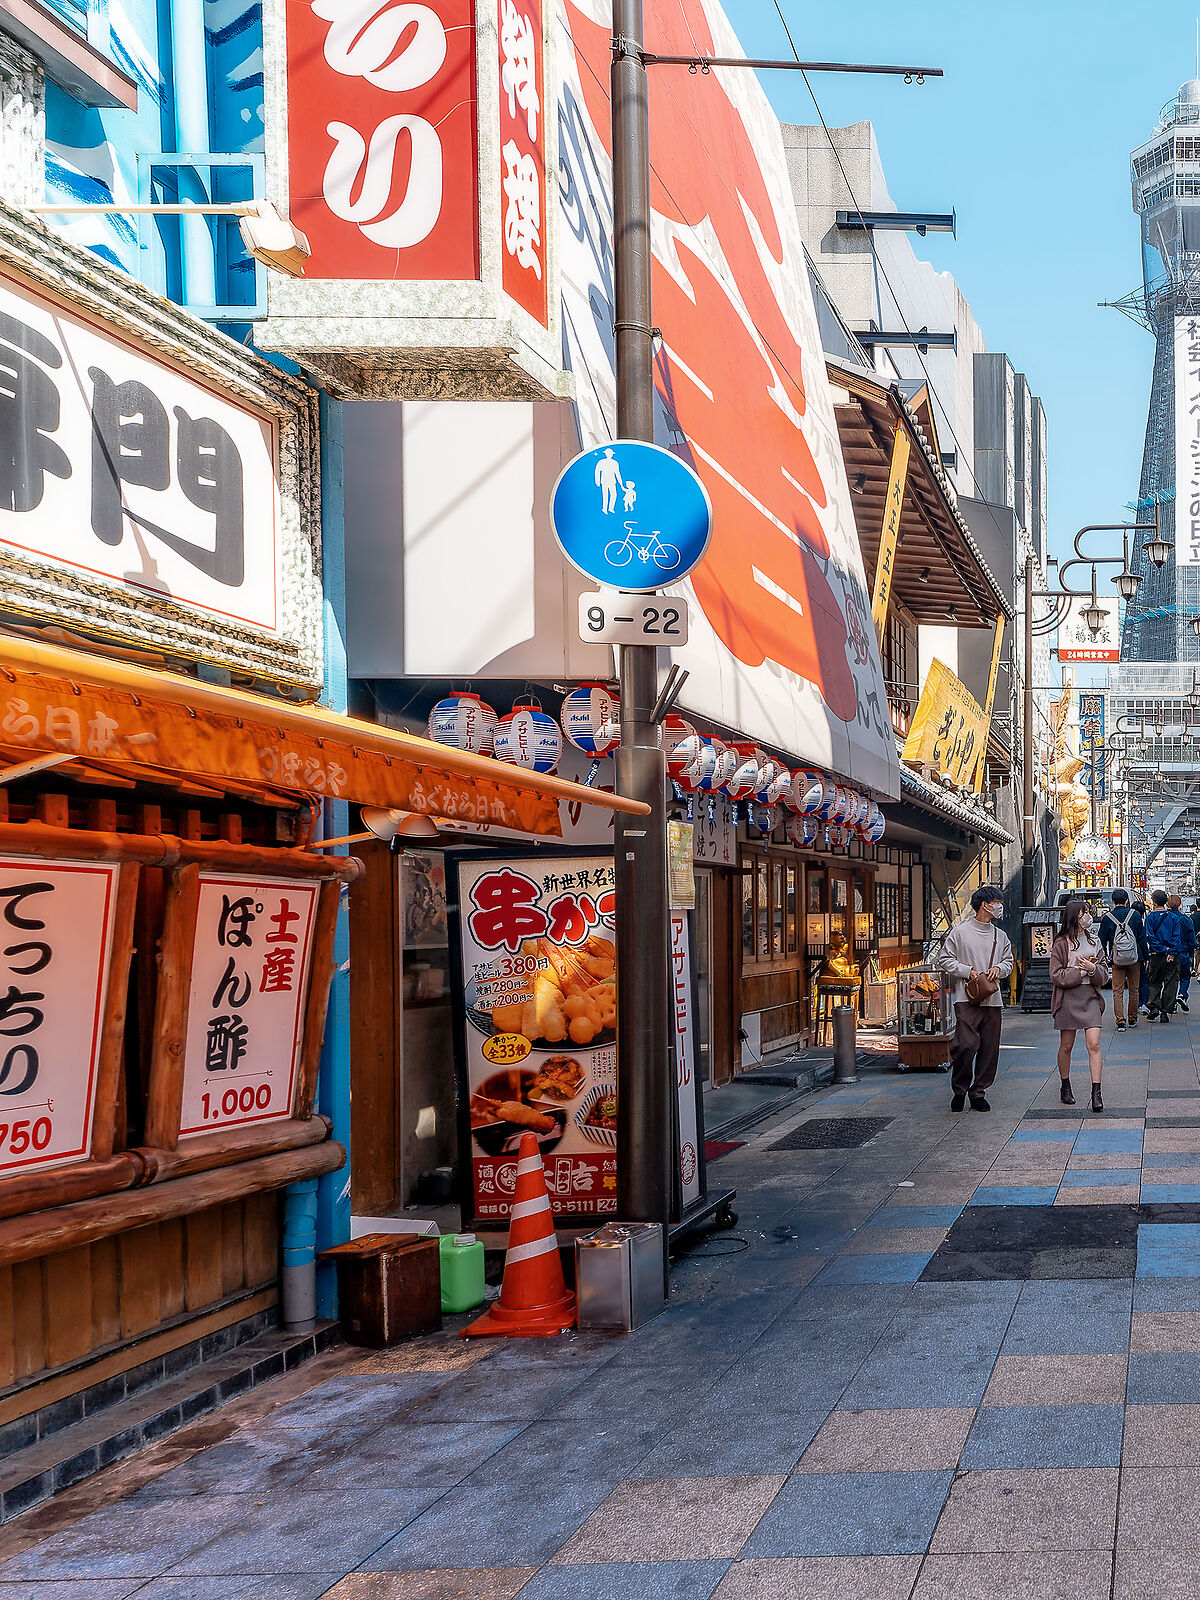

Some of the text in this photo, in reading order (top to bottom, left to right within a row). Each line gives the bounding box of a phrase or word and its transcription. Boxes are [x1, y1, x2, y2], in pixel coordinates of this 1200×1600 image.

[435, 722, 456, 732] Asahi
[463, 706, 477, 750] アサヒビール
[570, 713, 590, 722] Asahi
[1080, 695, 1103, 738] 麻雀
[518, 720, 531, 763] アサヒビール
[539, 737, 559, 747] Asahi
[258, 898, 301, 993] 土産
[474, 970, 502, 982] 生ビール
[500, 955, 549, 977] 380円
[0, 881, 55, 1096] てっちり
[205, 894, 264, 1072] ぽん酢
[671, 917, 691, 1088] アサヒビール
[487, 1044, 527, 1061] 全33種
[492, 1035, 518, 1046] 串かつ
[200, 1084, 272, 1120] 1,000
[478, 1164, 495, 1194] 酒処
